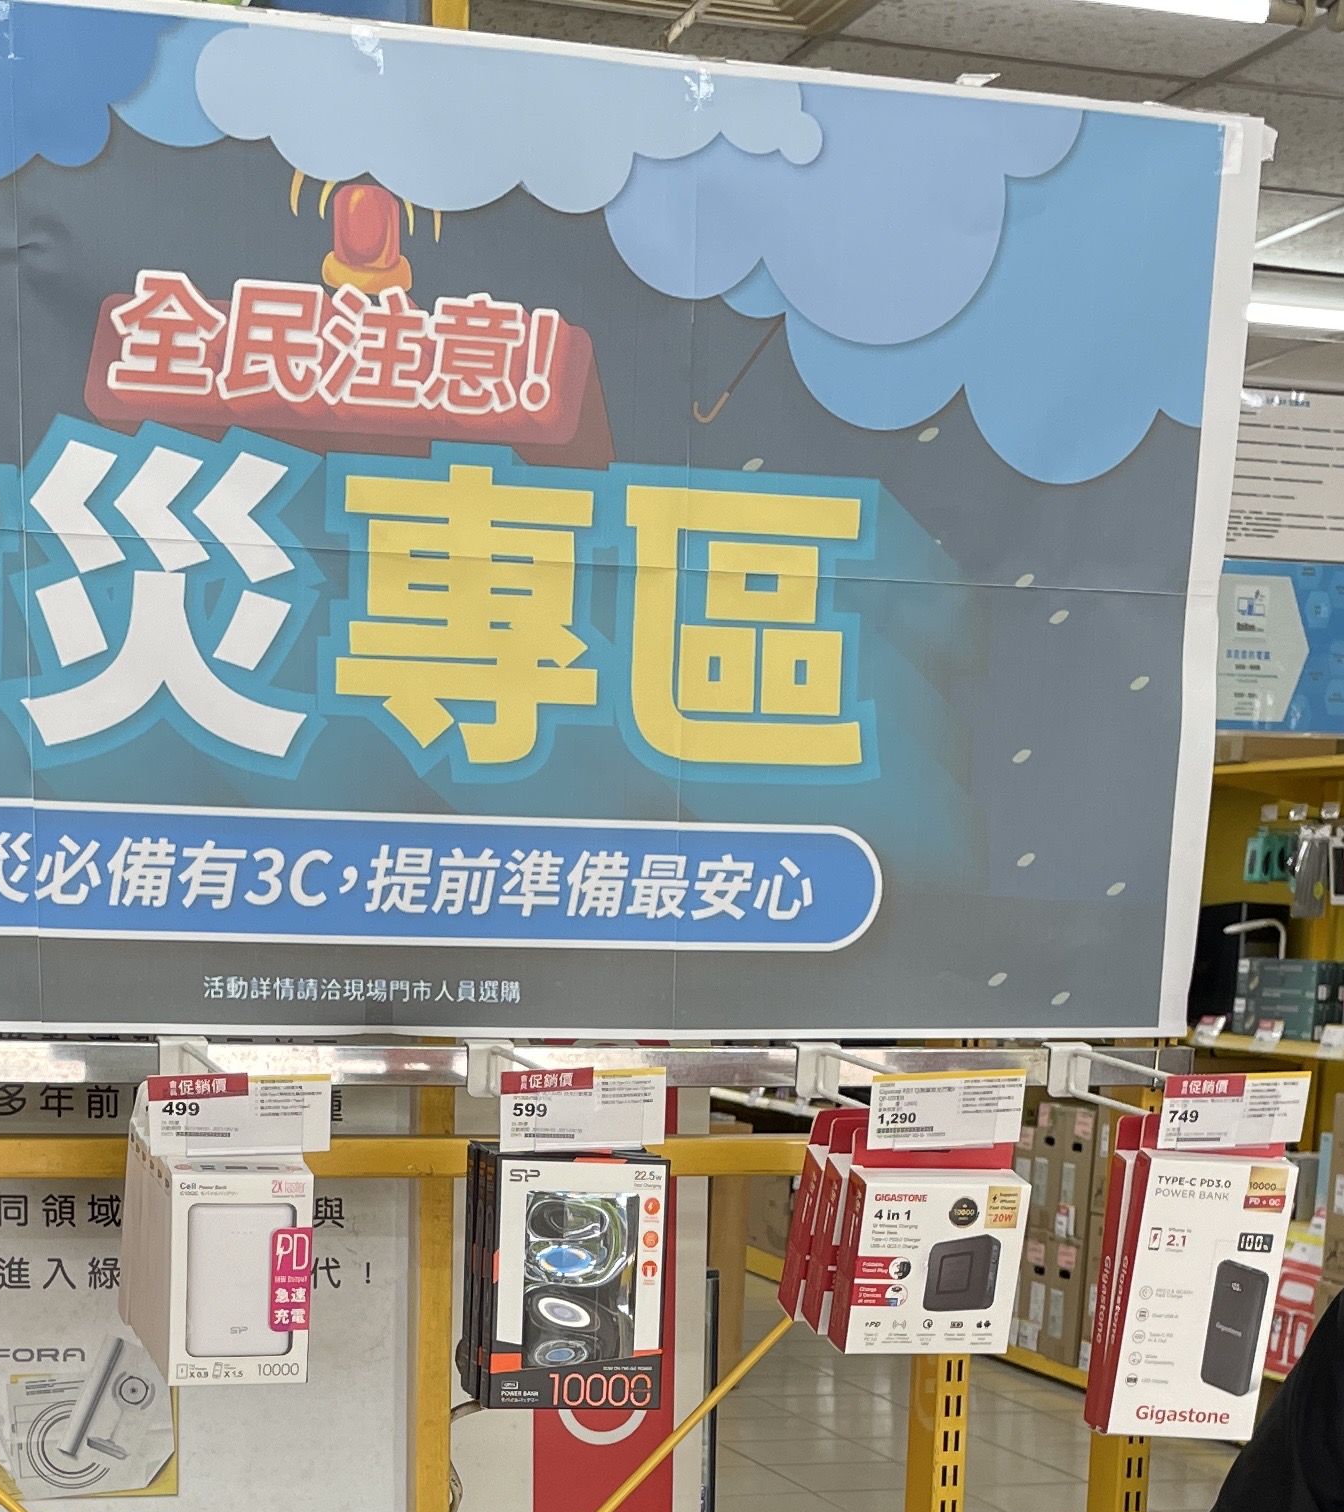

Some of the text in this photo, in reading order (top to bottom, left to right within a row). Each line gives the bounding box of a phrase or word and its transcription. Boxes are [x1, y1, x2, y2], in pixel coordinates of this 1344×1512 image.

[109, 270, 559, 417] 全民注意!
[178, 1077, 228, 1097] 促銷價
[528, 1073, 573, 1089] 促銷價
[1189, 1078, 1229, 1095] 促銷價
[161, 1101, 200, 1117] 499
[512, 1102, 548, 1118] 599
[1168, 1109, 1199, 1124] 749
[877, 1112, 917, 1127] 1,290
[509, 1169, 541, 1182] SP
[1157, 1175, 1232, 1188] TYPE-C PD3.0
[272, 1180, 283, 1194] 2X
[1249, 1181, 1277, 1191] 10000
[1155, 1188, 1230, 1200] POWER BANK
[313, 1196, 345, 1229] 與
[874, 1209, 912, 1220] 4 in 1
[1166, 1234, 1187, 1247] 2.1
[275, 1233, 309, 1271] PD
[275, 1288, 306, 1303] 急速
[274, 1309, 306, 1324] 充電
[257, 1362, 300, 1377] 10000
[548, 1373, 652, 1407] 10000
[1135, 1404, 1230, 1424] Gigastone
